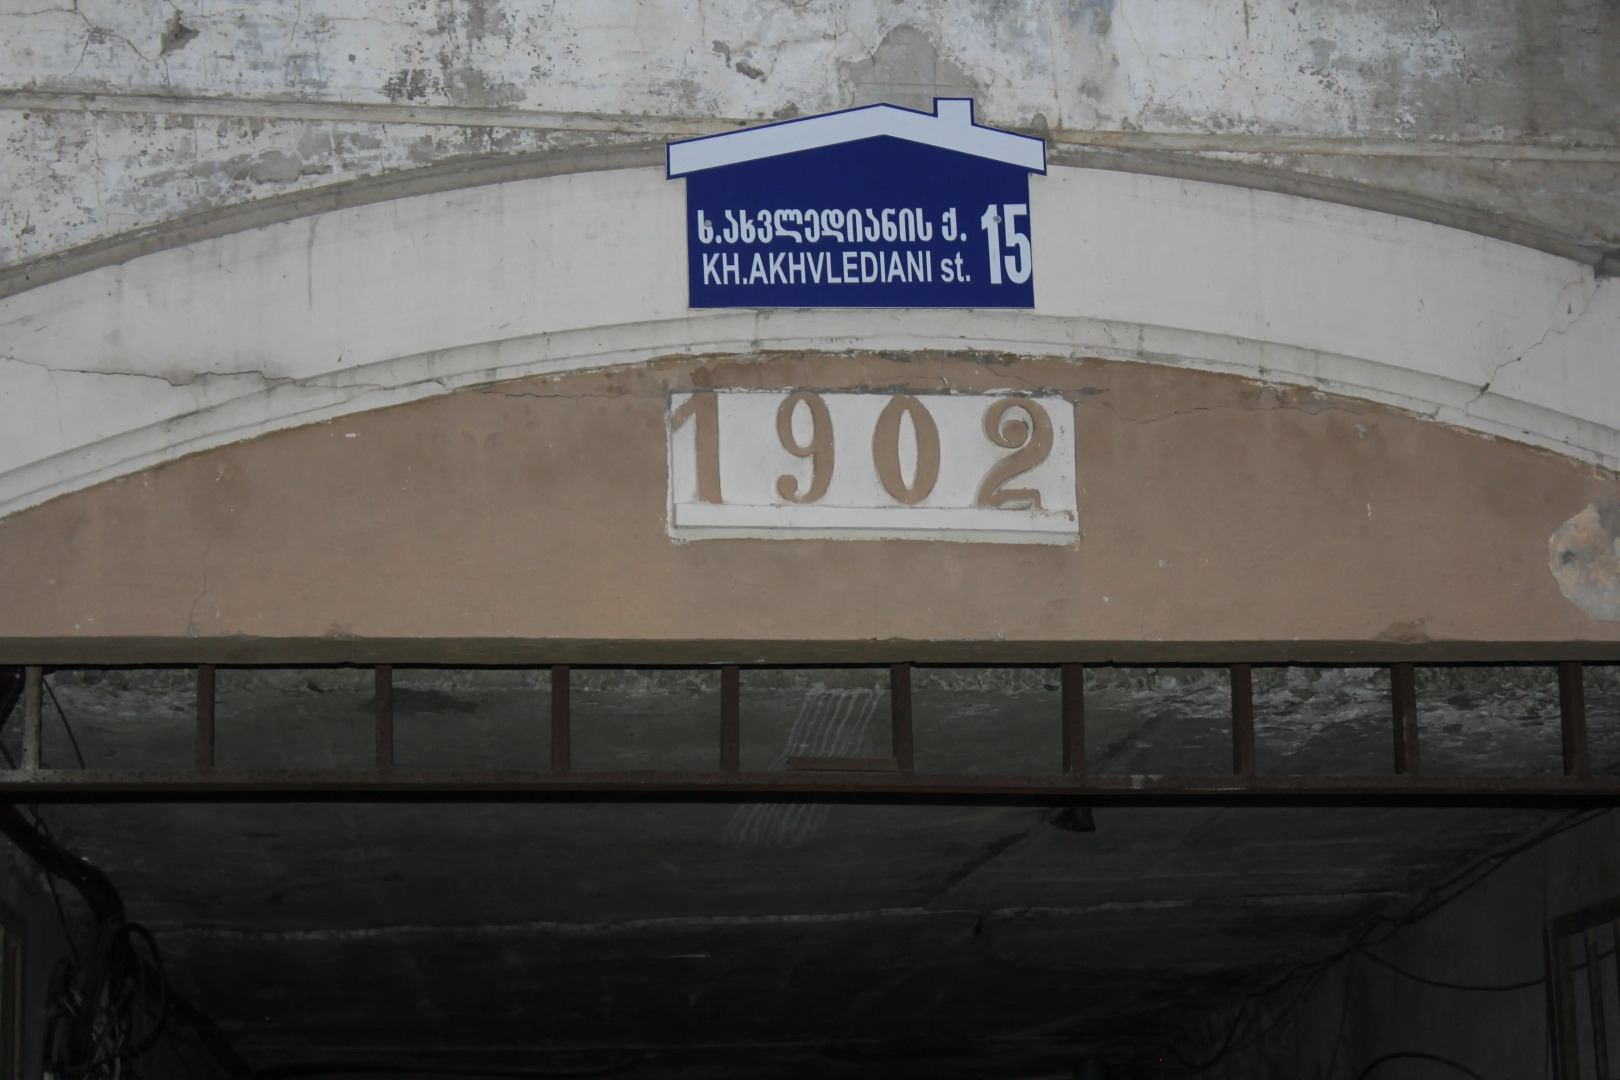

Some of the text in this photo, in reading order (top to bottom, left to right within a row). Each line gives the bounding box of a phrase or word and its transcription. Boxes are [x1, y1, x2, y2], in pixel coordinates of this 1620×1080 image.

[941, 207, 967, 242] ქ.
[980, 203, 1032, 284] 15
[702, 250, 971, 285] KH.AKHVLEDIANI st.
[671, 390, 1054, 511] 1902
